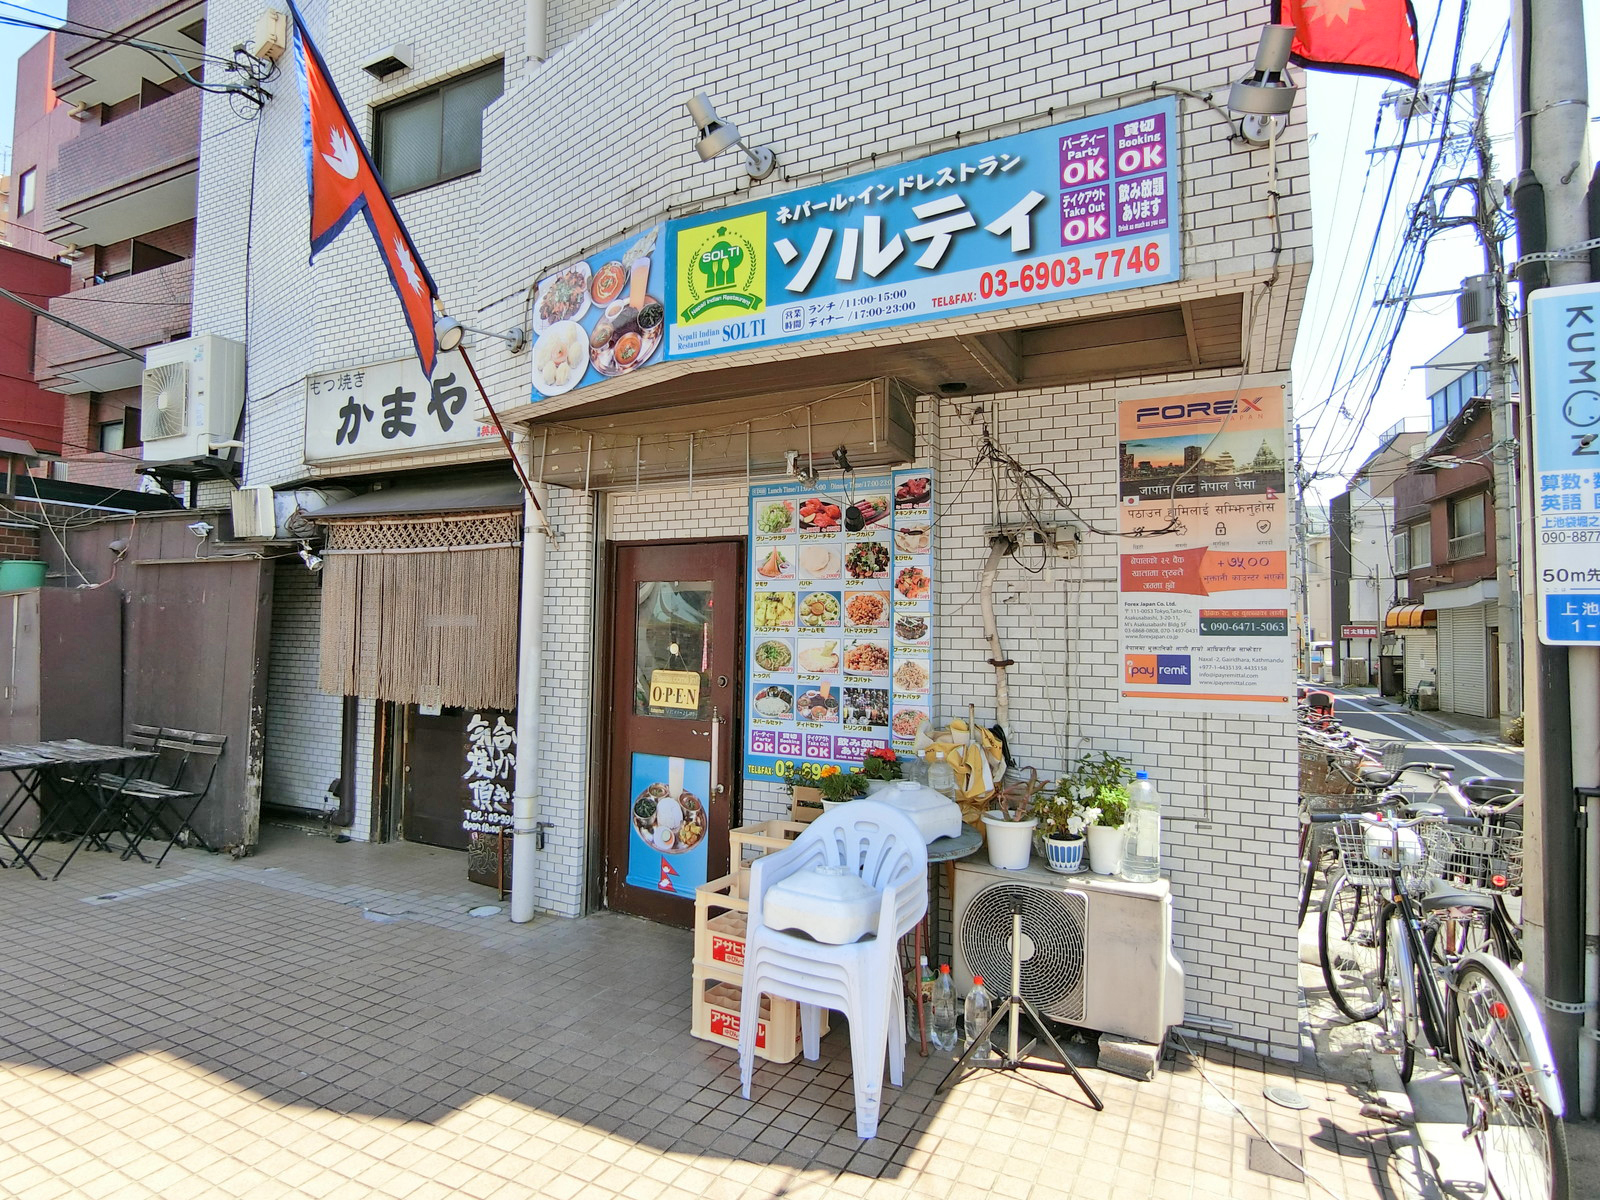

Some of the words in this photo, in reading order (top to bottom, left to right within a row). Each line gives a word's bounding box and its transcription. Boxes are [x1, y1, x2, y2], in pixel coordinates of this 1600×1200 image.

[1123, 118, 1155, 137] 貸切
[1062, 134, 1105, 151] パーティー
[1118, 133, 1161, 149] Booking
[1067, 147, 1099, 160] Party
[1118, 144, 1162, 172] OK
[1063, 157, 1105, 183] OK
[1062, 188, 1105, 208] テイクアウト
[1118, 176, 1164, 203] 飲み放題
[1064, 207, 1086, 218] Take
[1088, 202, 1105, 213] Out
[1122, 197, 1161, 221] あります
[1064, 215, 1106, 241] OK
[1118, 223, 1129, 232] Drink
[1135, 221, 1145, 229] much
[773, 190, 1045, 292] ソルティ
[702, 246, 740, 263] SOLTI
[931, 292, 977, 308] TEL&FAX:
[979, 242, 1160, 299] 03-6903-7746
[691, 300, 707, 316] Nepali
[707, 295, 722, 305] Indian
[722, 293, 752, 307] Restaurant
[808, 302, 836, 314] ランチ
[785, 309, 801, 319] 営業
[808, 315, 844, 328] ディナー
[722, 319, 766, 342] SOLTI
[785, 320, 801, 330] 時間
[678, 331, 698, 343] Nepali
[700, 328, 720, 338] Indian
[678, 338, 711, 350] Restaurant
[310, 371, 365, 395] もつ焼き
[1562, 305, 1600, 457] KUMON
[335, 372, 468, 446] かまや
[1137, 397, 1263, 423] FOREX
[1200, 480, 1229, 492] नेपाल
[1234, 476, 1257, 490] पैसा
[1541, 493, 1581, 511] 英語
[1543, 568, 1600, 582] 50m先
[1561, 602, 1600, 616] 上池
[1210, 622, 1285, 631] 090-6471-5063
[1126, 660, 1155, 678] ipay
[1159, 665, 1188, 675] remit
[753, 742, 774, 752] OK
[779, 744, 800, 754] OK
[807, 747, 829, 757] OK
[748, 764, 774, 775] TEL&FAX:
